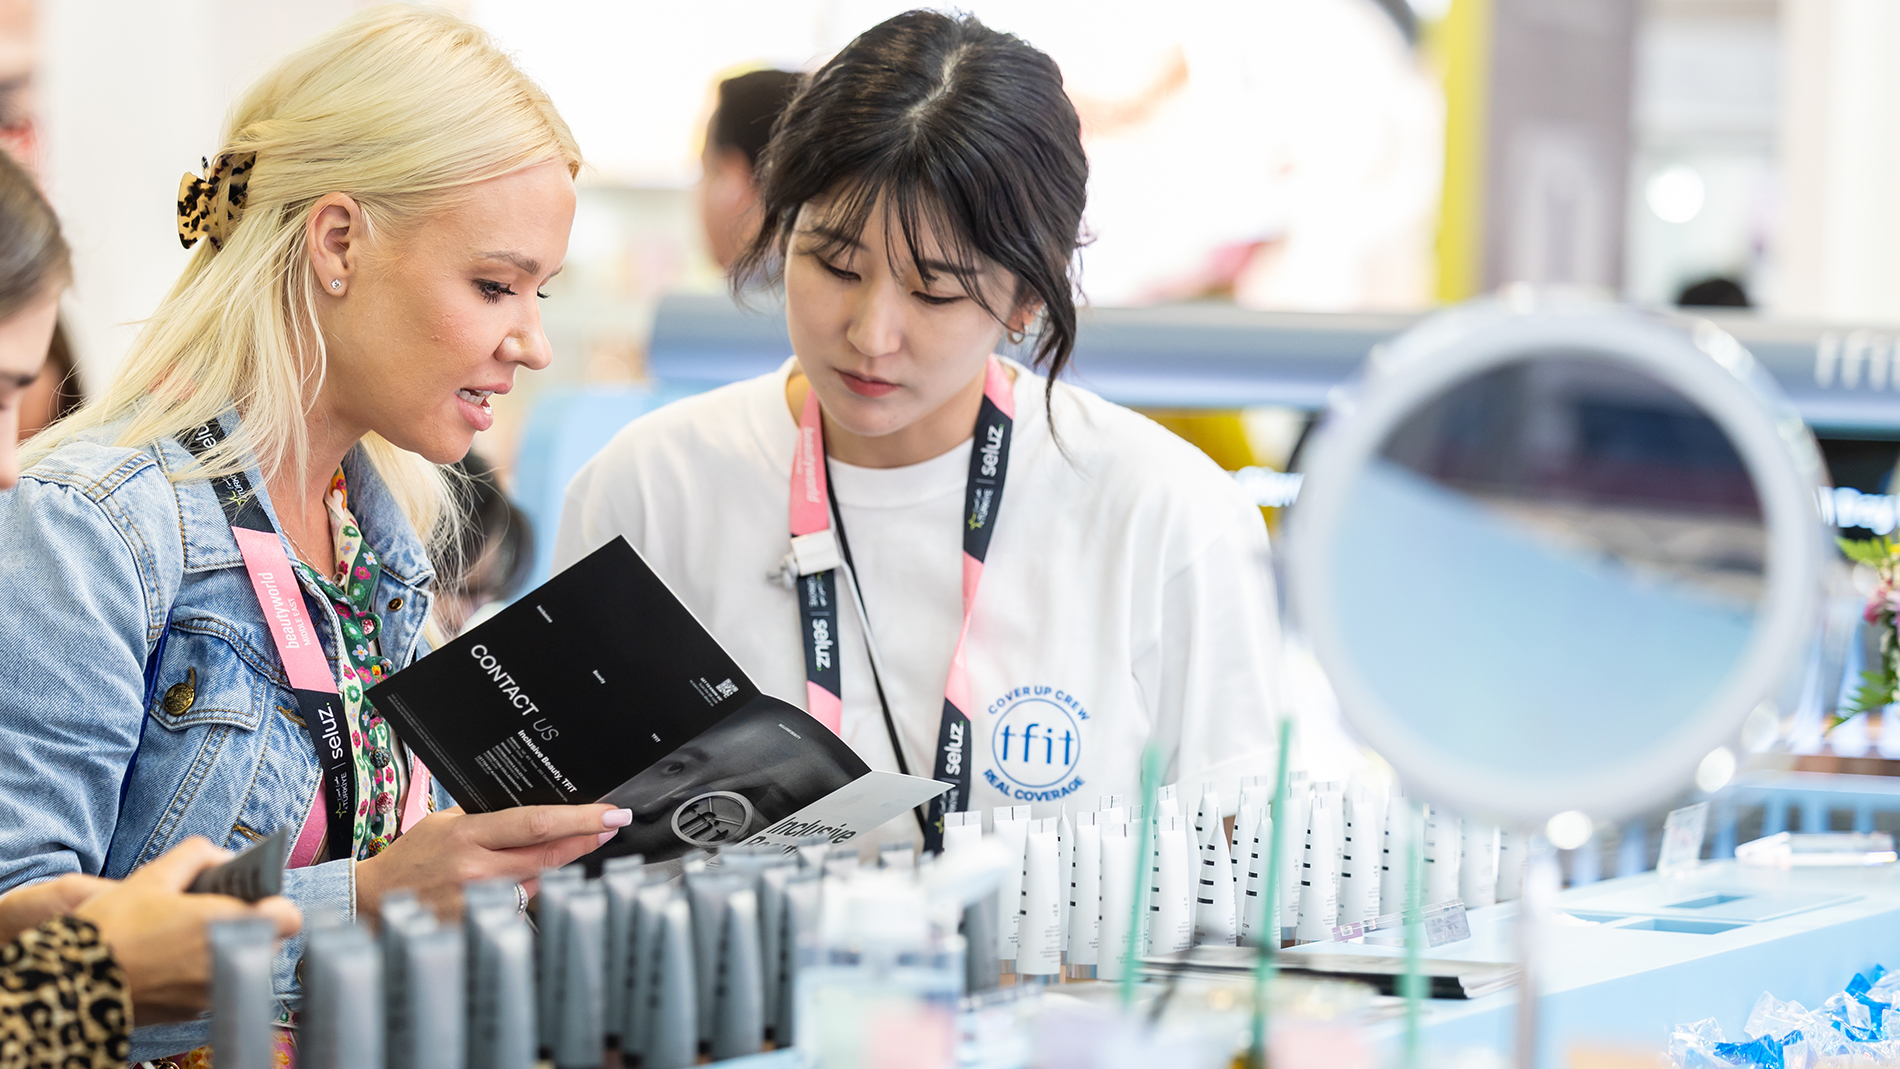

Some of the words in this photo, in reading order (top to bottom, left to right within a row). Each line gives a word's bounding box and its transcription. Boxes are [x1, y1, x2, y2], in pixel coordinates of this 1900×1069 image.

[258, 572, 300, 648] beautyworld
[287, 598, 300, 616] EAST
[295, 617, 311, 646] MIDDLE
[470, 643, 540, 717] CONTACT
[532, 717, 560, 742] US
[988, 686, 1030, 714] COVER
[1034, 686, 1052, 695] UP
[1055, 690, 1090, 720] CREW
[517, 729, 545, 758] Inclusive
[539, 756, 564, 781] Beauty,
[560, 778, 577, 793] TFIT
[1000, 723, 1075, 766] tfit
[983, 769, 1010, 797] REAL
[1014, 776, 1085, 801] COVERAGE
